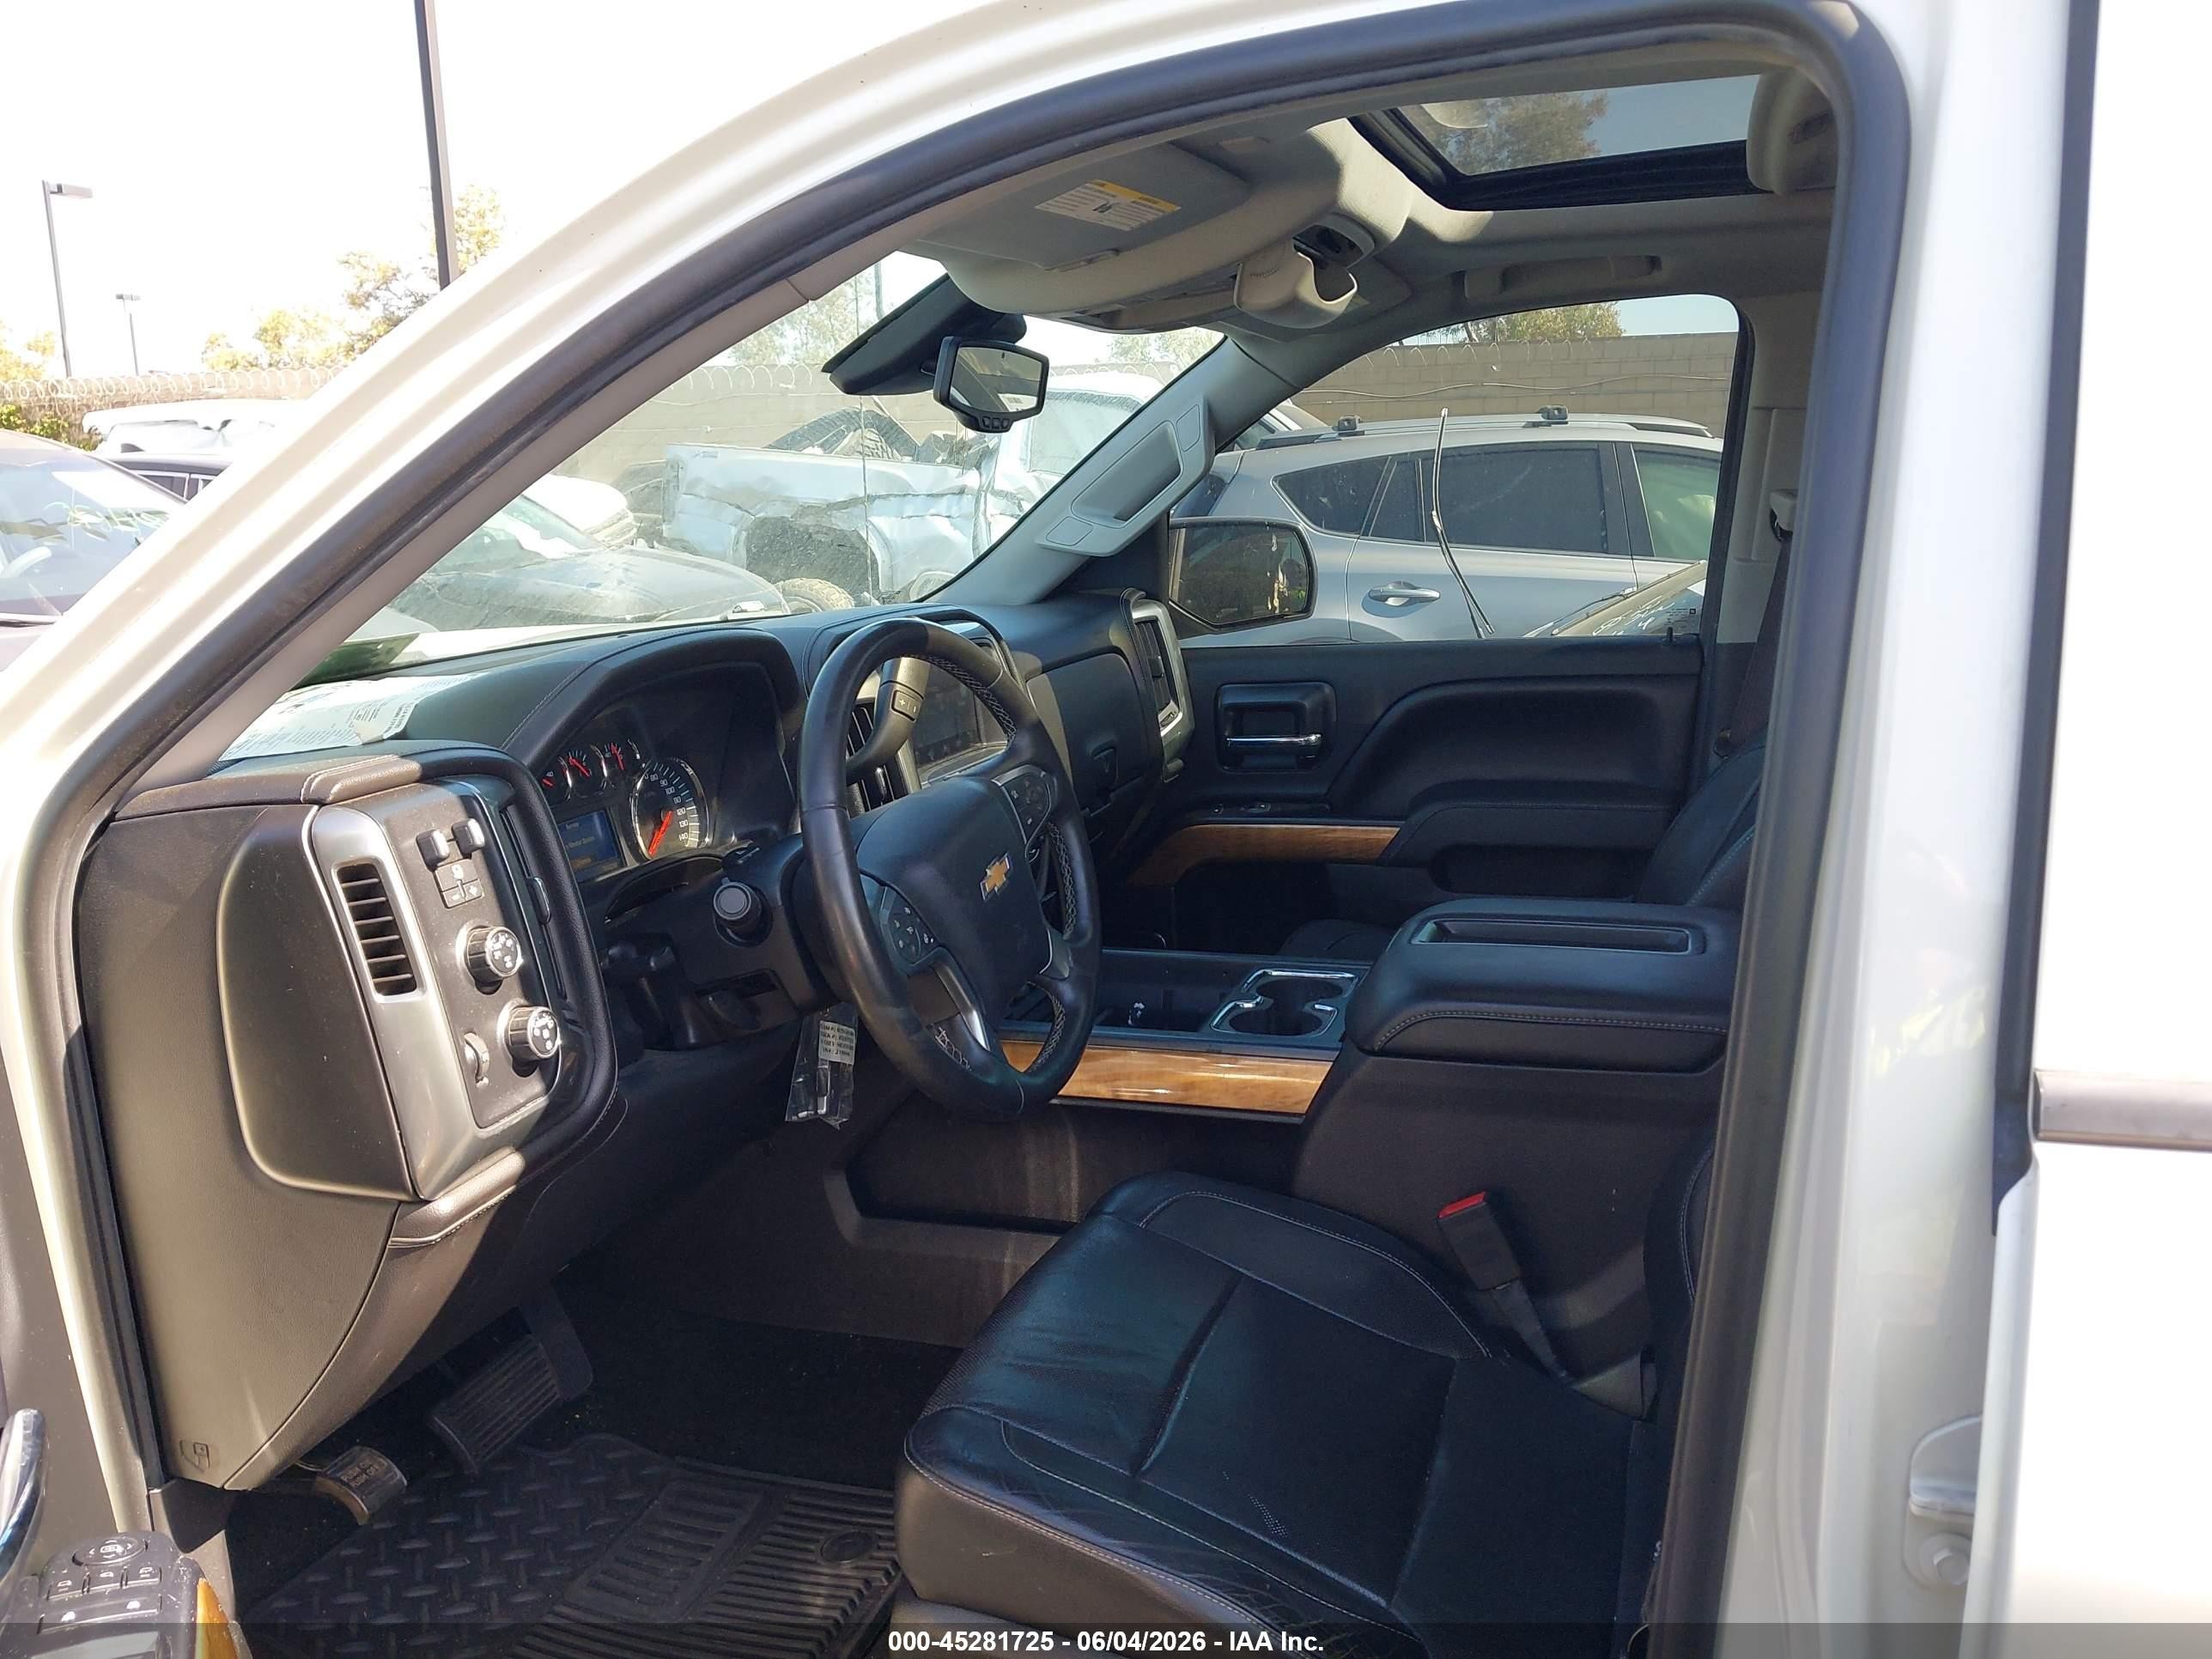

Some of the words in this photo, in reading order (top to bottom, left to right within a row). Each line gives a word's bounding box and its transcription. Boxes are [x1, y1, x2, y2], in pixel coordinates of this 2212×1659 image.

[659, 778, 668, 787] 90
[665, 786, 676, 795] 100
[673, 796, 682, 805] 110
[677, 807, 686, 816] 120
[678, 819, 689, 828] 130
[678, 832, 689, 842] 140
